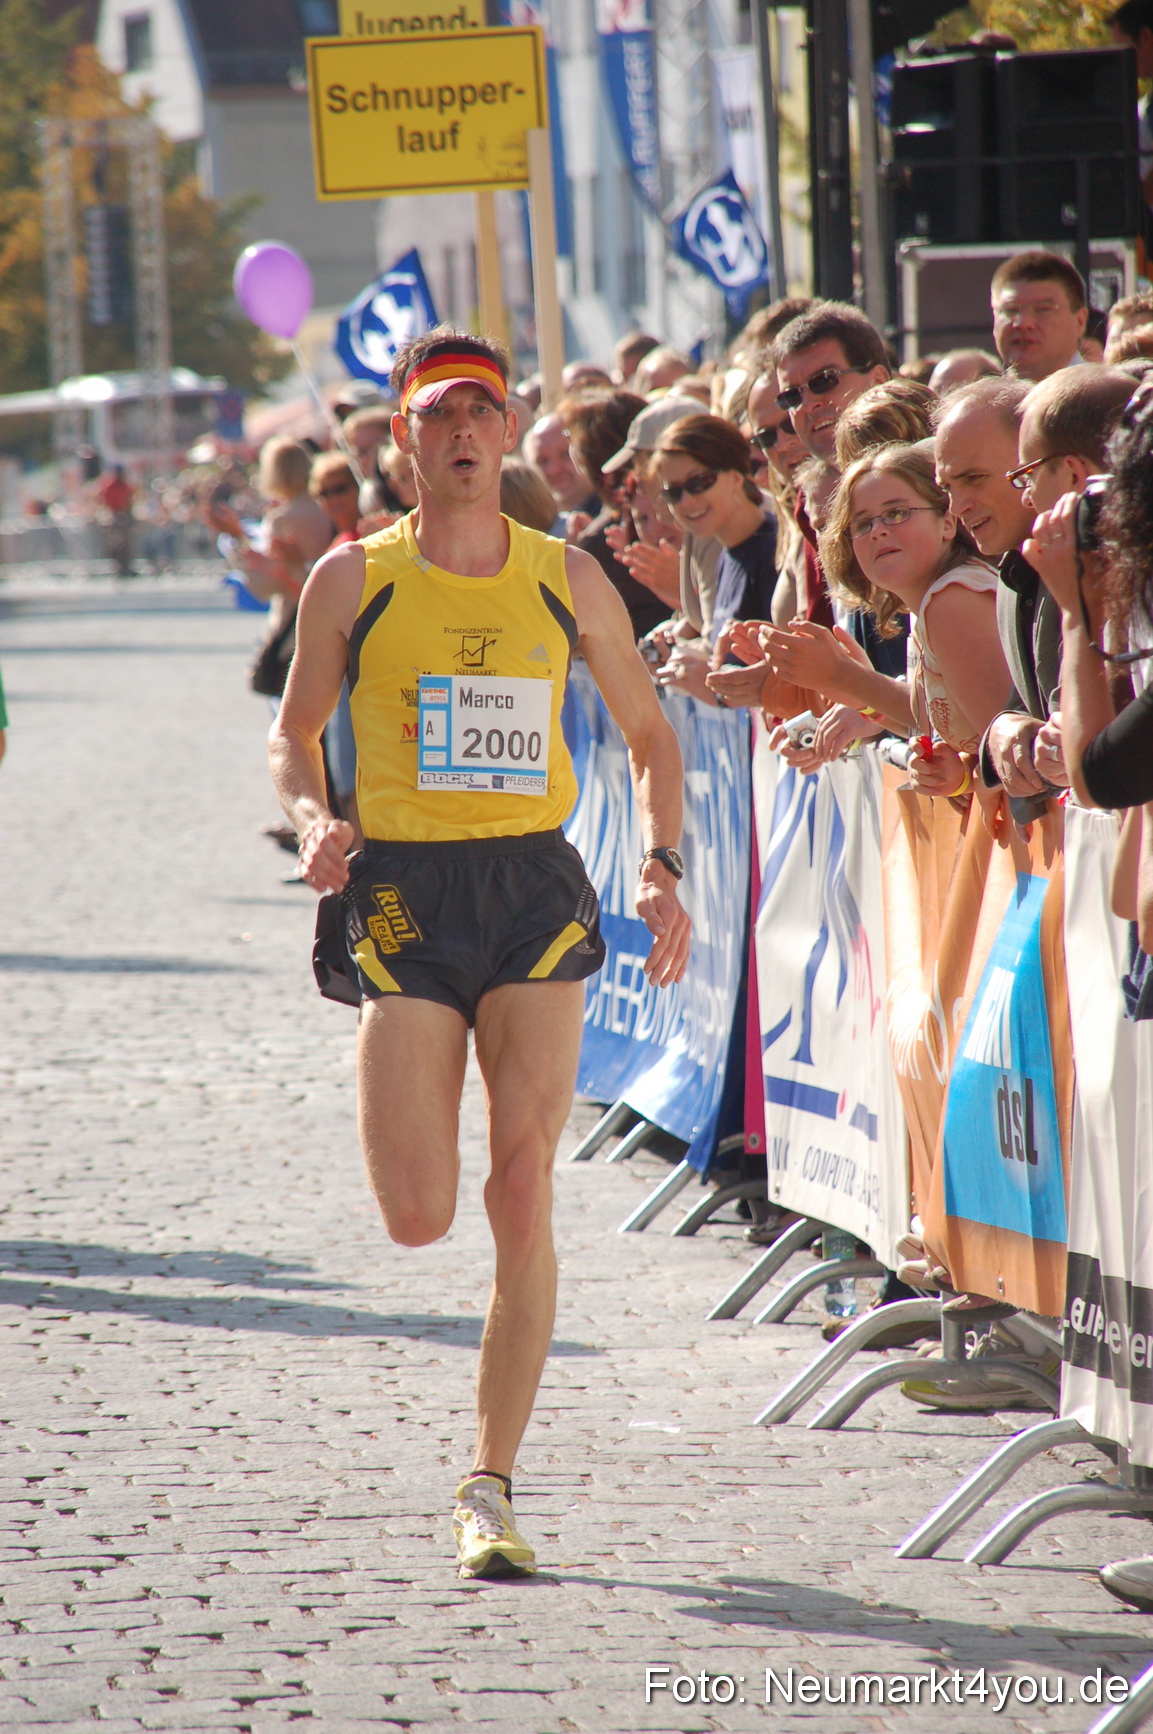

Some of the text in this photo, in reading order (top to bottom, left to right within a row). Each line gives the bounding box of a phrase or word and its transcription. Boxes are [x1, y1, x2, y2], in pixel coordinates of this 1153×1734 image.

[326, 81, 526, 114] Schnupper-
[397, 120, 460, 154] lauf
[459, 686, 514, 709] Marco
[426, 720, 434, 736] A
[461, 727, 542, 762] 2000
[420, 772, 475, 785] BOCK
[505, 775, 546, 788] PFLEIDERER
[376, 890, 416, 940] Run!
[997, 1073, 1039, 1166] dsl
[802, 1145, 857, 1197] COMPUTR
